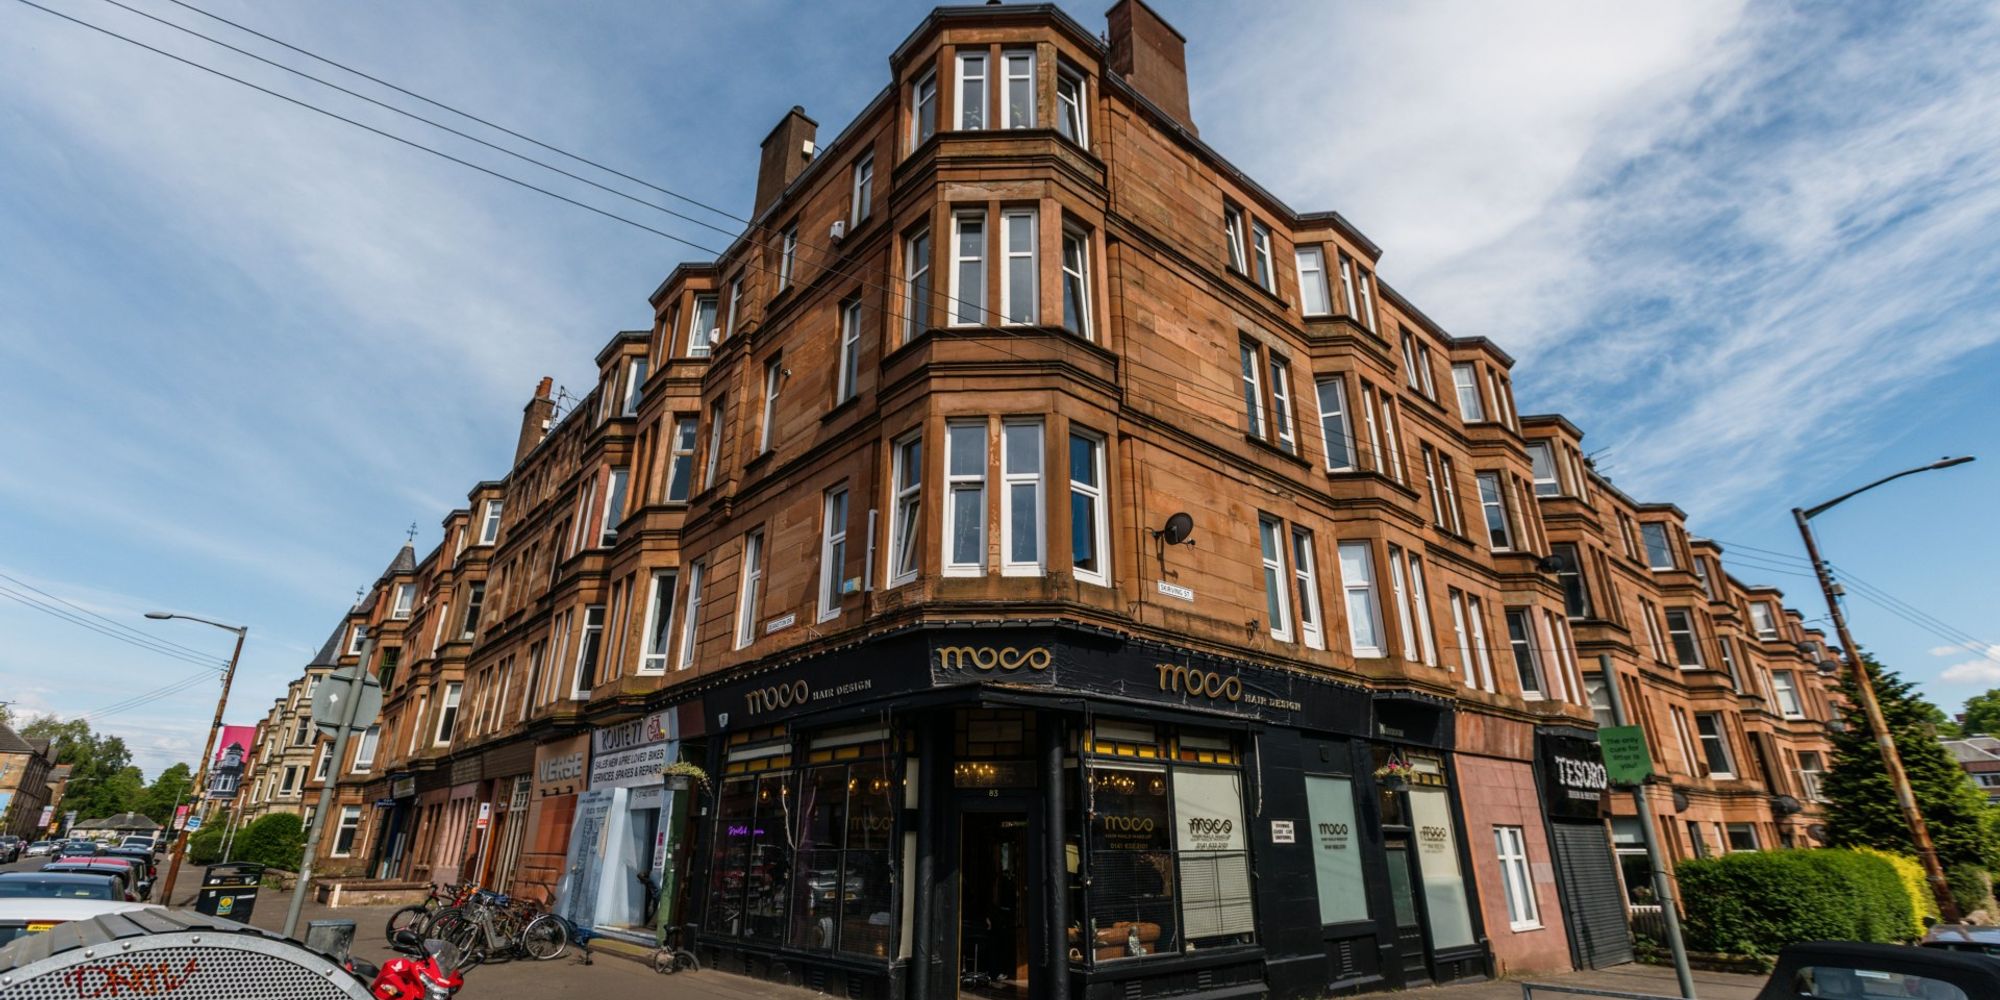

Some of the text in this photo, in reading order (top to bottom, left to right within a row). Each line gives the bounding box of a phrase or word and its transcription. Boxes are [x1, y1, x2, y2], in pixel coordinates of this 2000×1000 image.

[812, 688, 834, 701] HAIR
[836, 679, 872, 696] DESIGN
[1244, 694, 1268, 705] HAIR
[1269, 698, 1301, 712] DESIGN
[601, 721, 643, 751] ROUTE 77
[647, 748, 664, 761] BIKES
[538, 752, 584, 784] VERSE
[615, 767, 634, 779] SPARES
[639, 763, 662, 776] REPAIRS
[1554, 755, 1607, 790] TESORO
